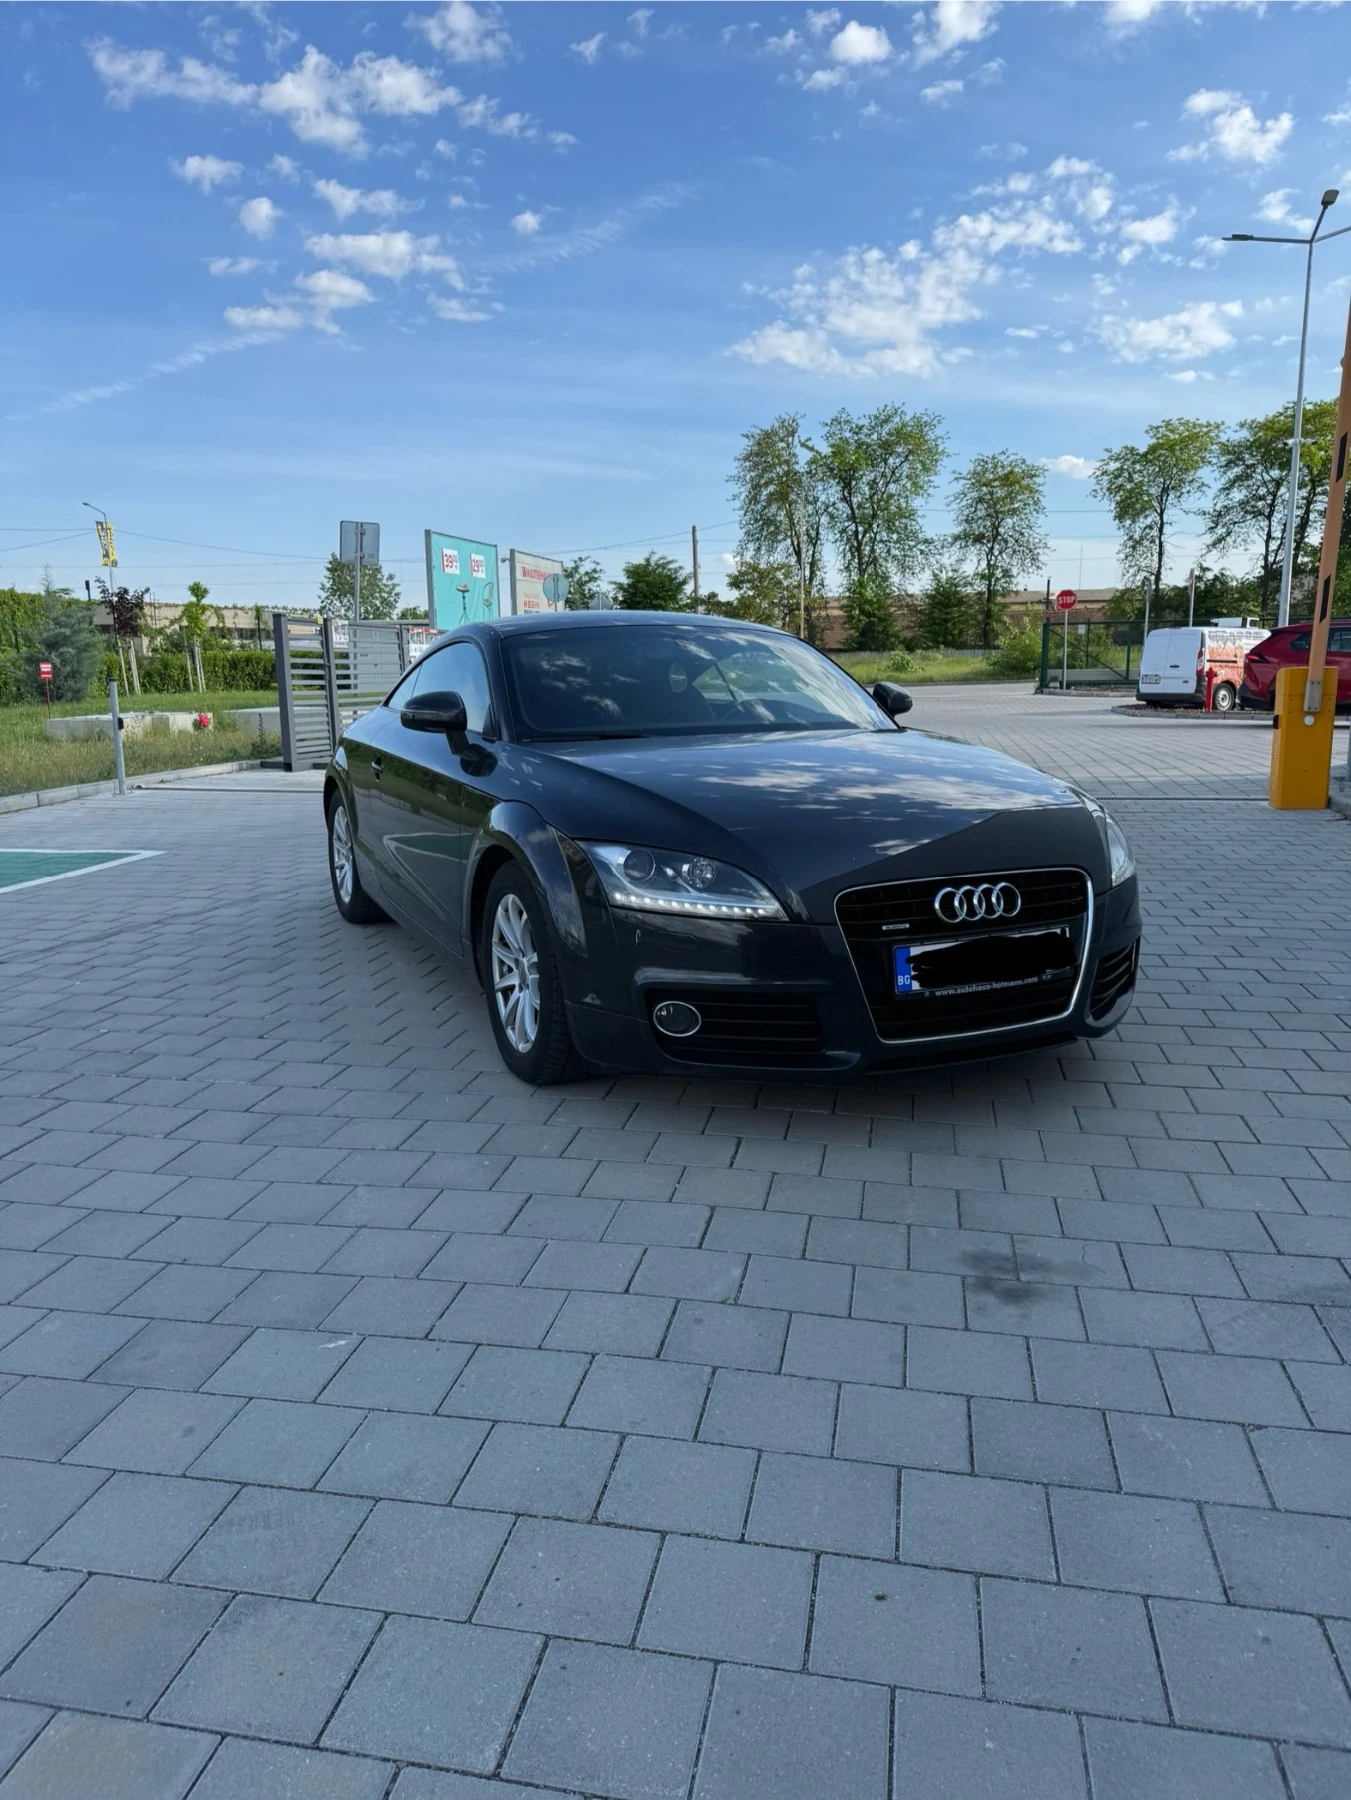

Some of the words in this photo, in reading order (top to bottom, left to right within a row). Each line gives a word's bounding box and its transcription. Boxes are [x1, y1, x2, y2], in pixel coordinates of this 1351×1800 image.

[1058, 595, 1076, 605] STOP
[897, 974, 911, 986] BG
[934, 976, 1039, 997] www.autohaus-hofmann.com
